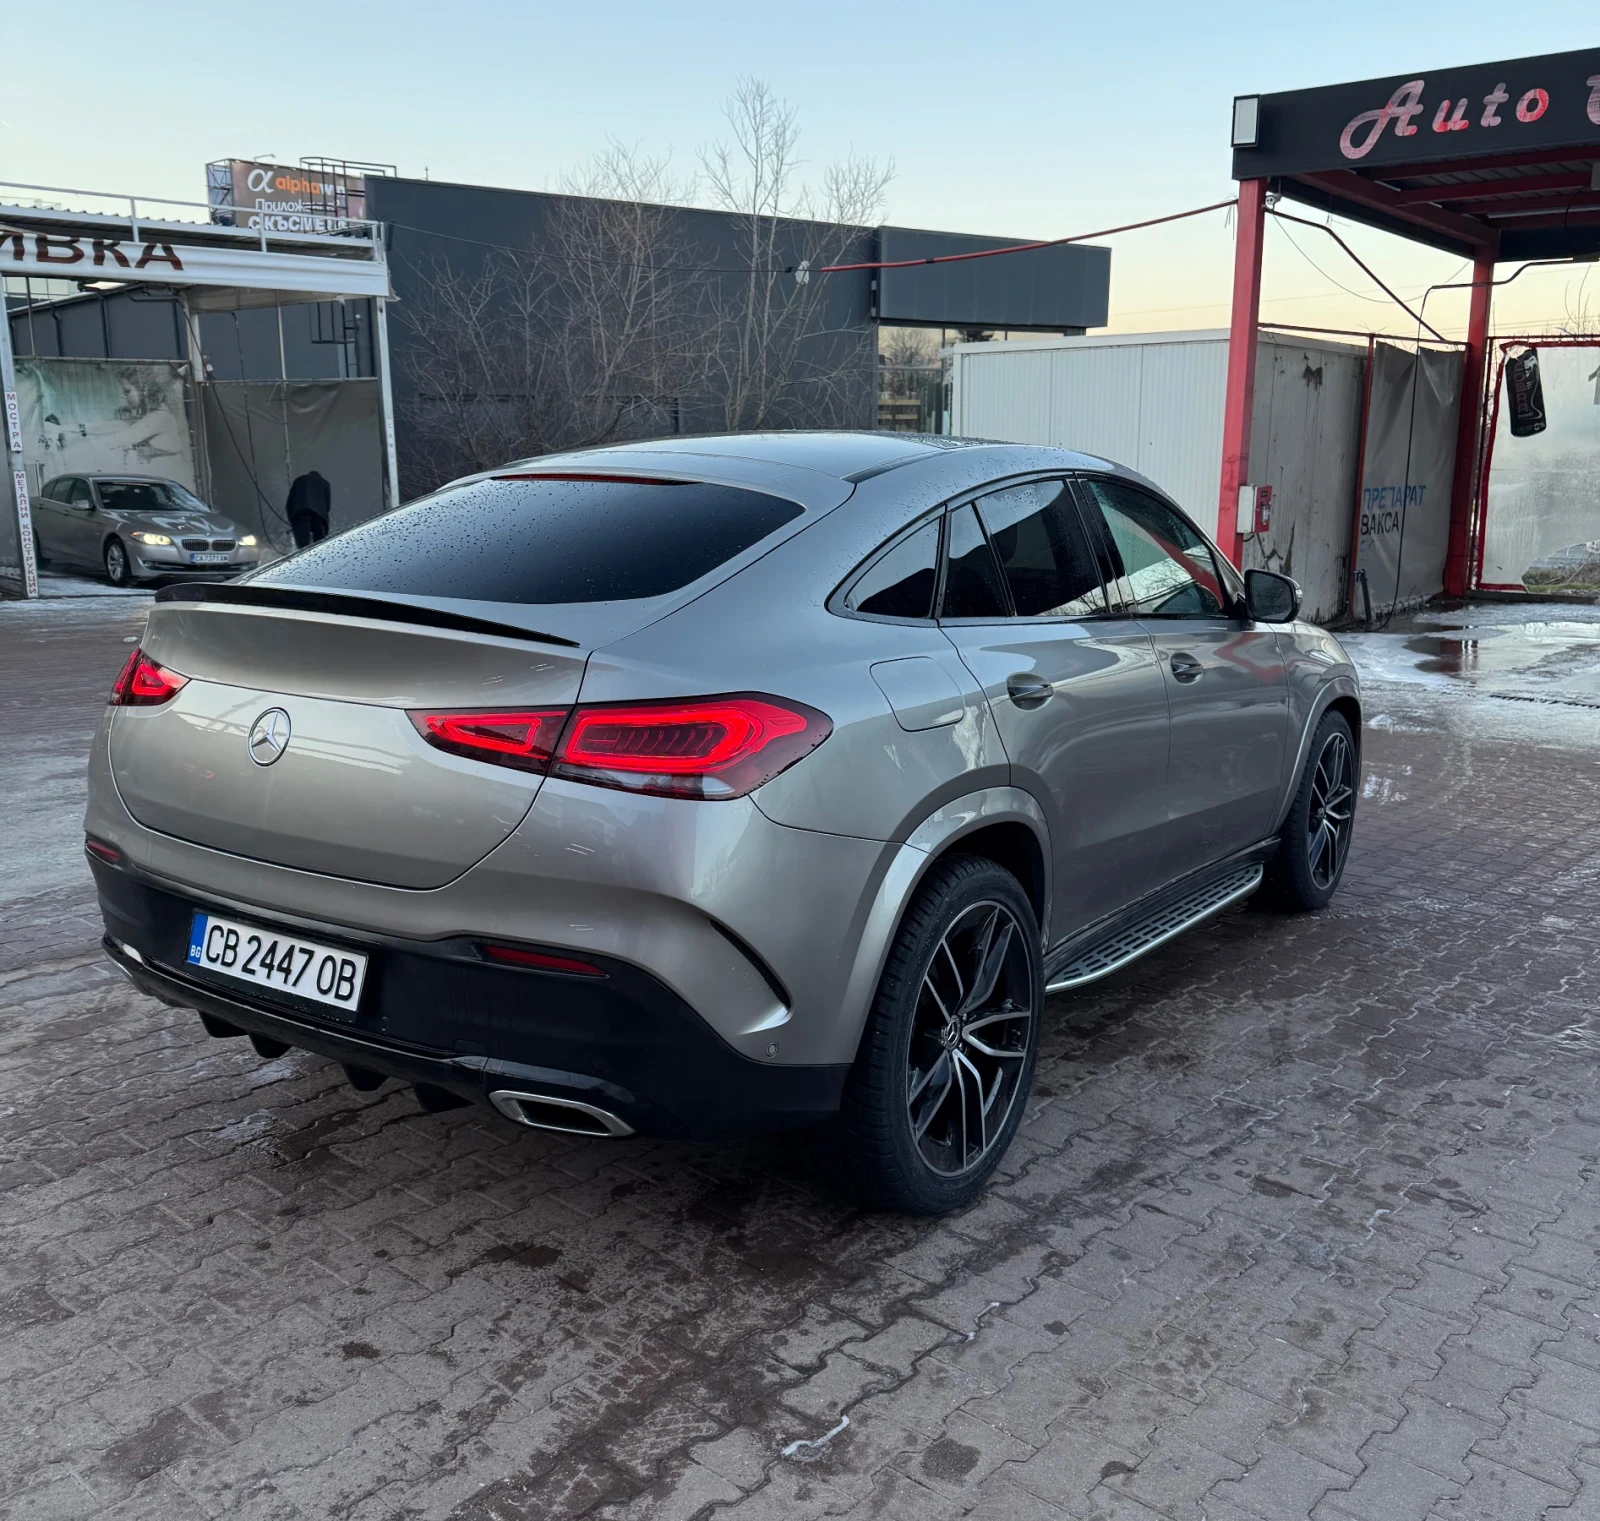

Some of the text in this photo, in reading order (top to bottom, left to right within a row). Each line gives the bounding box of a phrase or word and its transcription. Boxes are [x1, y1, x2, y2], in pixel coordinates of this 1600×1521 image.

[1340, 79, 1549, 160] Auto
[275, 175, 346, 197] alphawn
[6, 393, 22, 449] МОСТРА
[1360, 511, 1399, 536] ВАКСА
[22, 523, 37, 595] КОНСТРУКЦИИ
[190, 945, 202, 958] BG
[205, 924, 240, 967] CB
[241, 934, 315, 987] 2447
